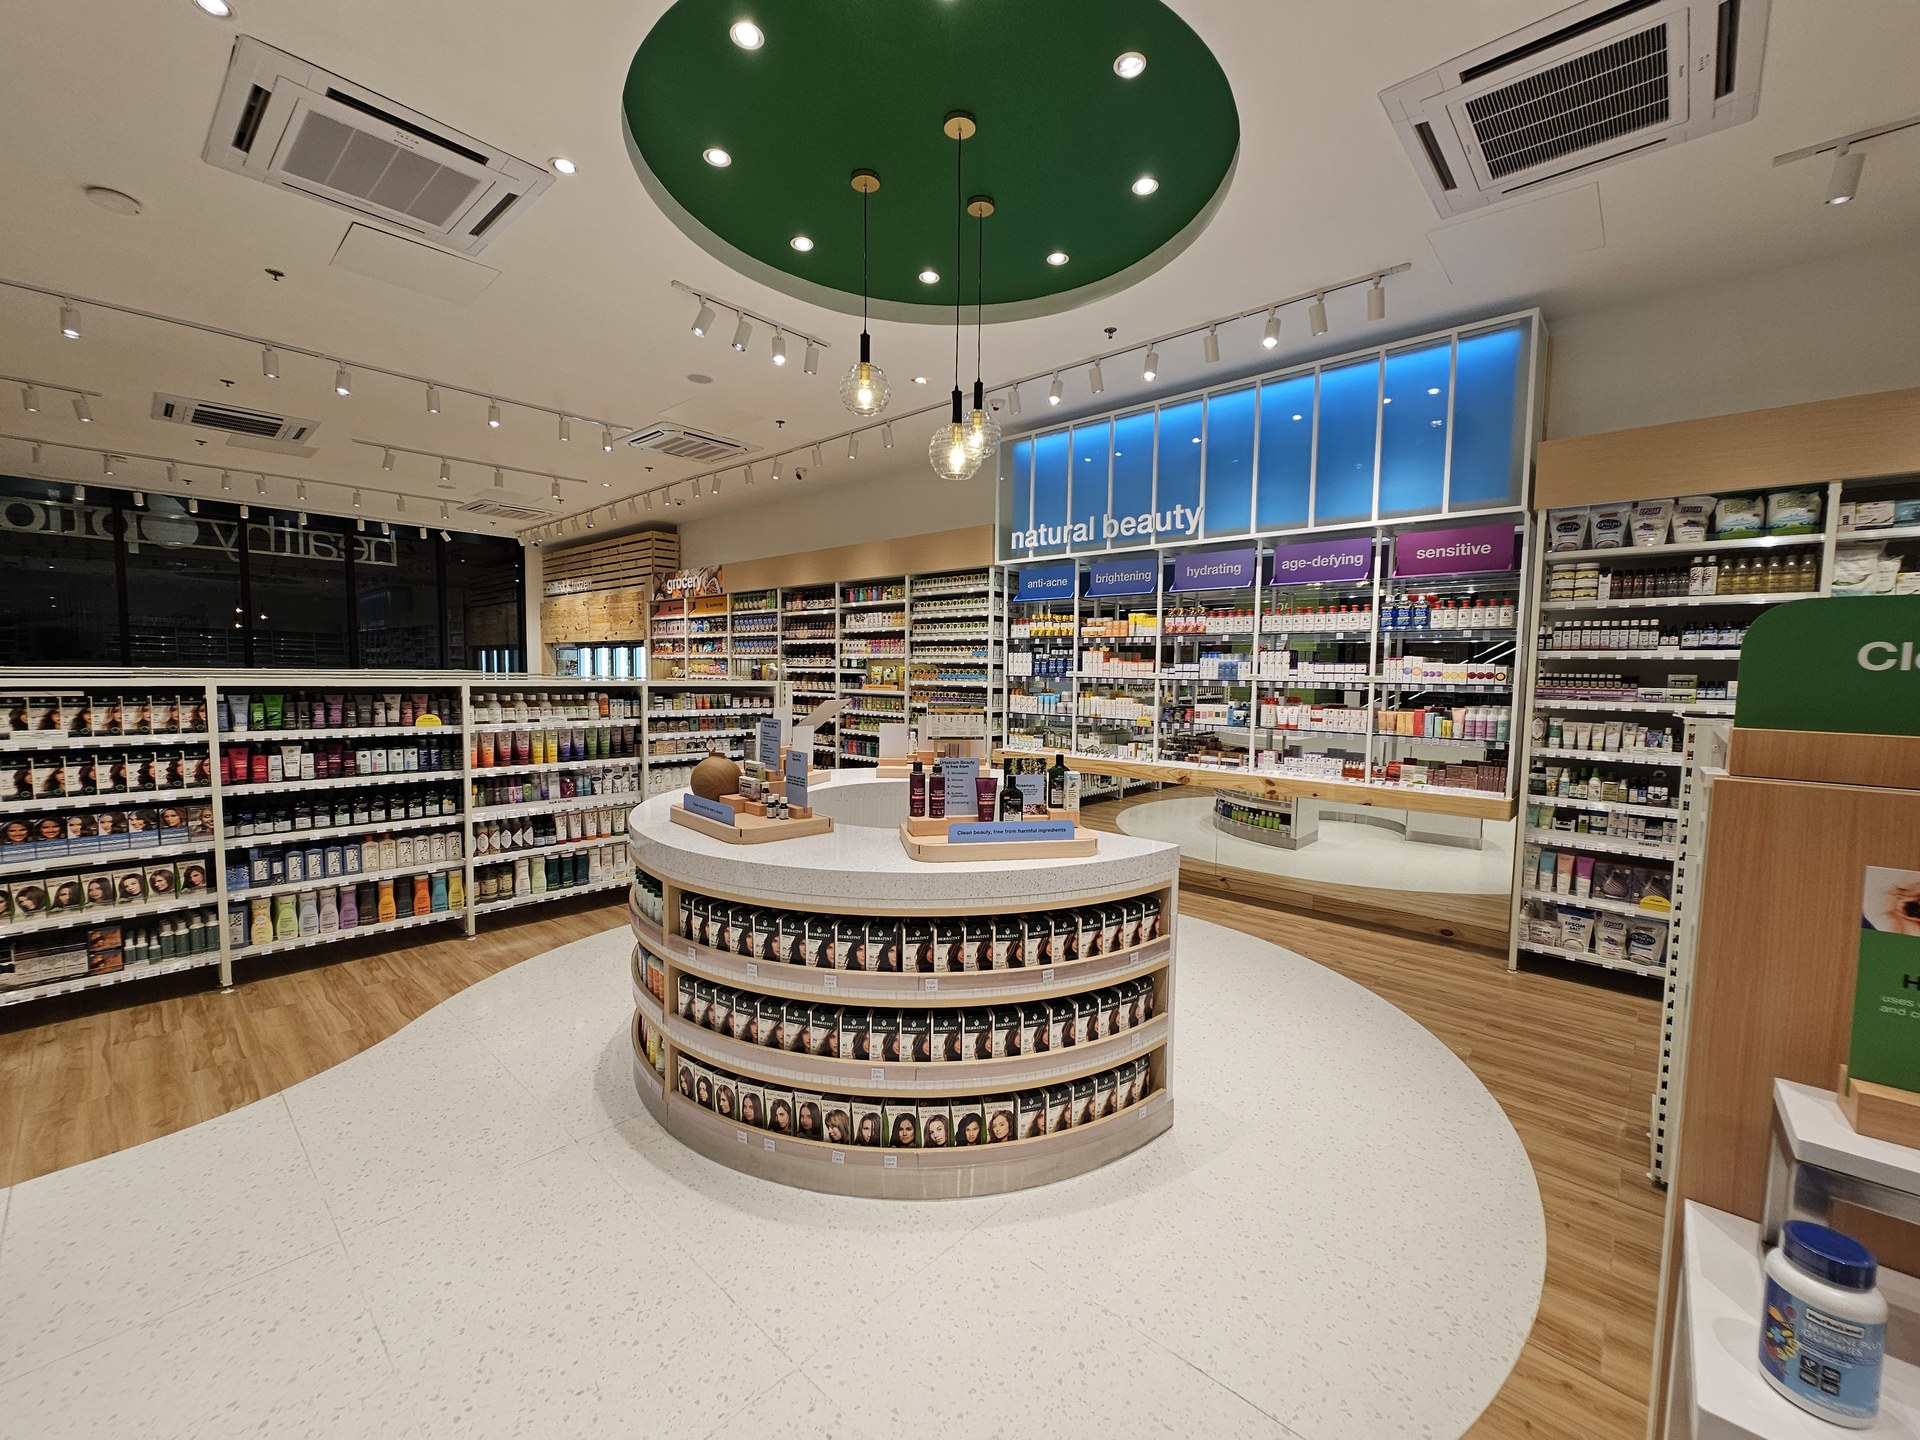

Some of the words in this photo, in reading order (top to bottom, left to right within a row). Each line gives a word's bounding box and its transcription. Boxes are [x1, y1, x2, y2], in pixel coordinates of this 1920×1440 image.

[1011, 515, 1095, 550] natural
[1103, 503, 1204, 539] beauty
[1415, 542, 1492, 560] sensitive
[1281, 552, 1364, 571] age-defying
[1095, 570, 1152, 585] brightening
[1186, 562, 1242, 578] hydrating
[666, 573, 703, 595] grocery
[1027, 577, 1068, 589] anti-acne
[1857, 641, 1920, 671] Cl
[1564, 920, 1586, 928] EPSOM
[1881, 996, 1914, 1006] uses
[1880, 1005, 1906, 1016] and
